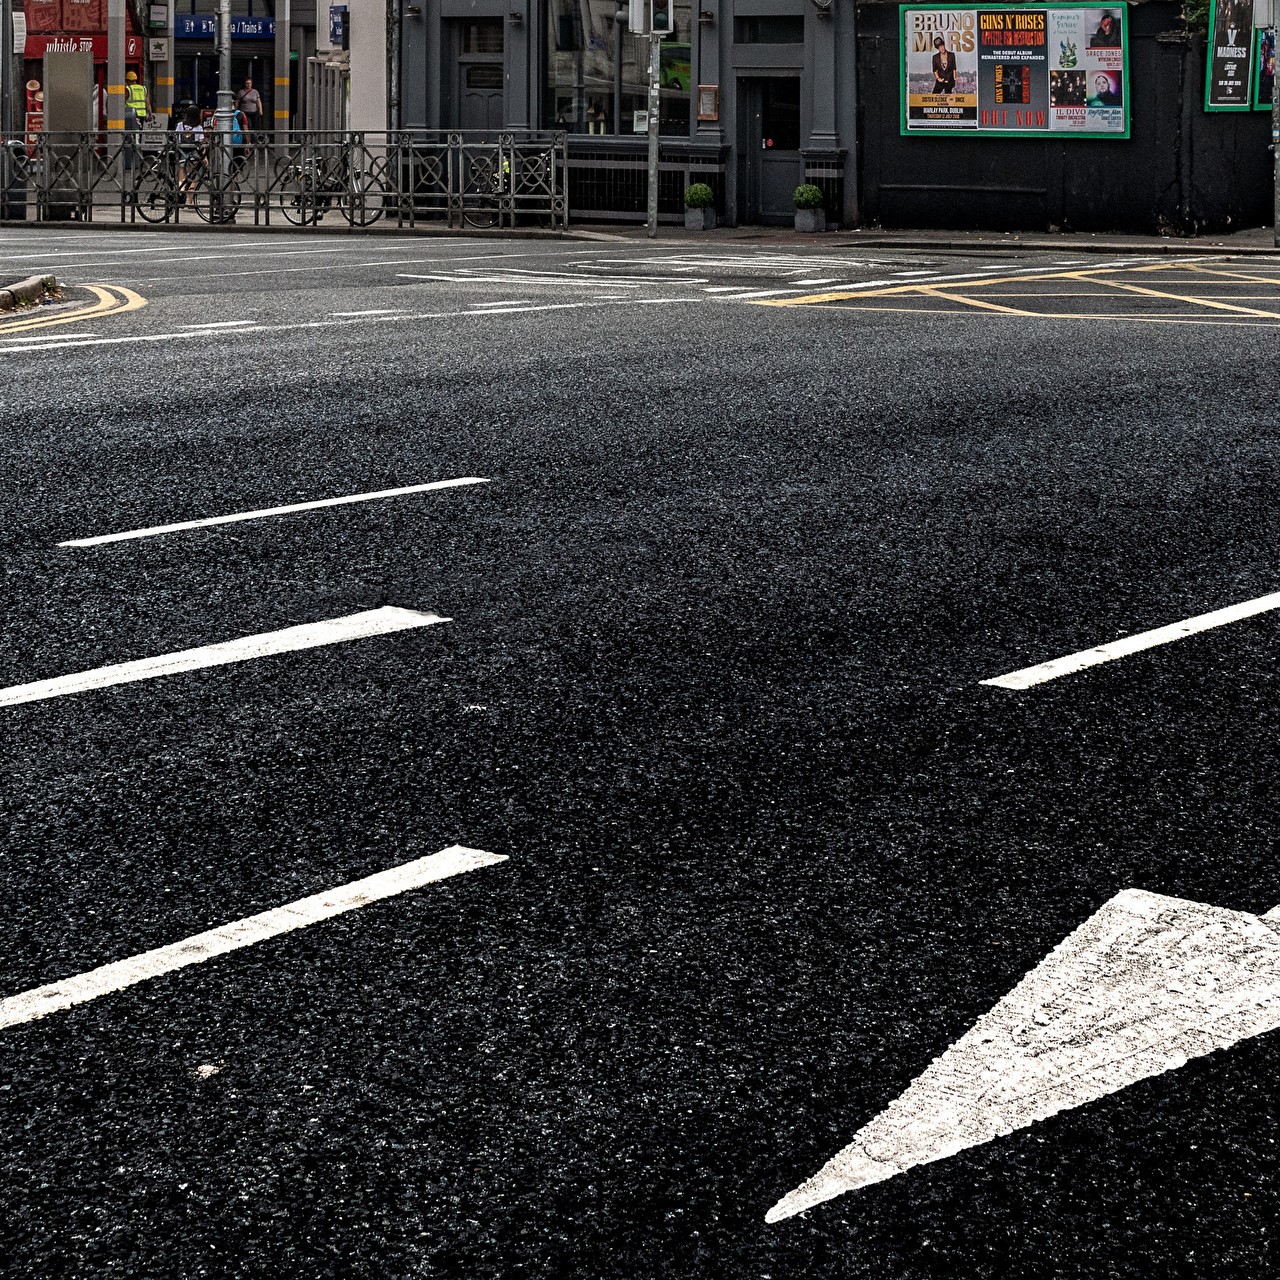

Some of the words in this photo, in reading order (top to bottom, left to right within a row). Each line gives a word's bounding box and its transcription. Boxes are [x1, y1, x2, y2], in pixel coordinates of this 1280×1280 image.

[241, 21, 257, 33] Trains
[912, 12, 975, 31] BRUNO
[980, 14, 1003, 30] GUNS
[1016, 14, 1044, 30] ROSES
[46, 37, 77, 53] whistle
[79, 41, 93, 52] STOP
[1217, 46, 1247, 58] MADNESS
[981, 109, 1008, 126] OUT
[1016, 109, 1045, 126] NOW
